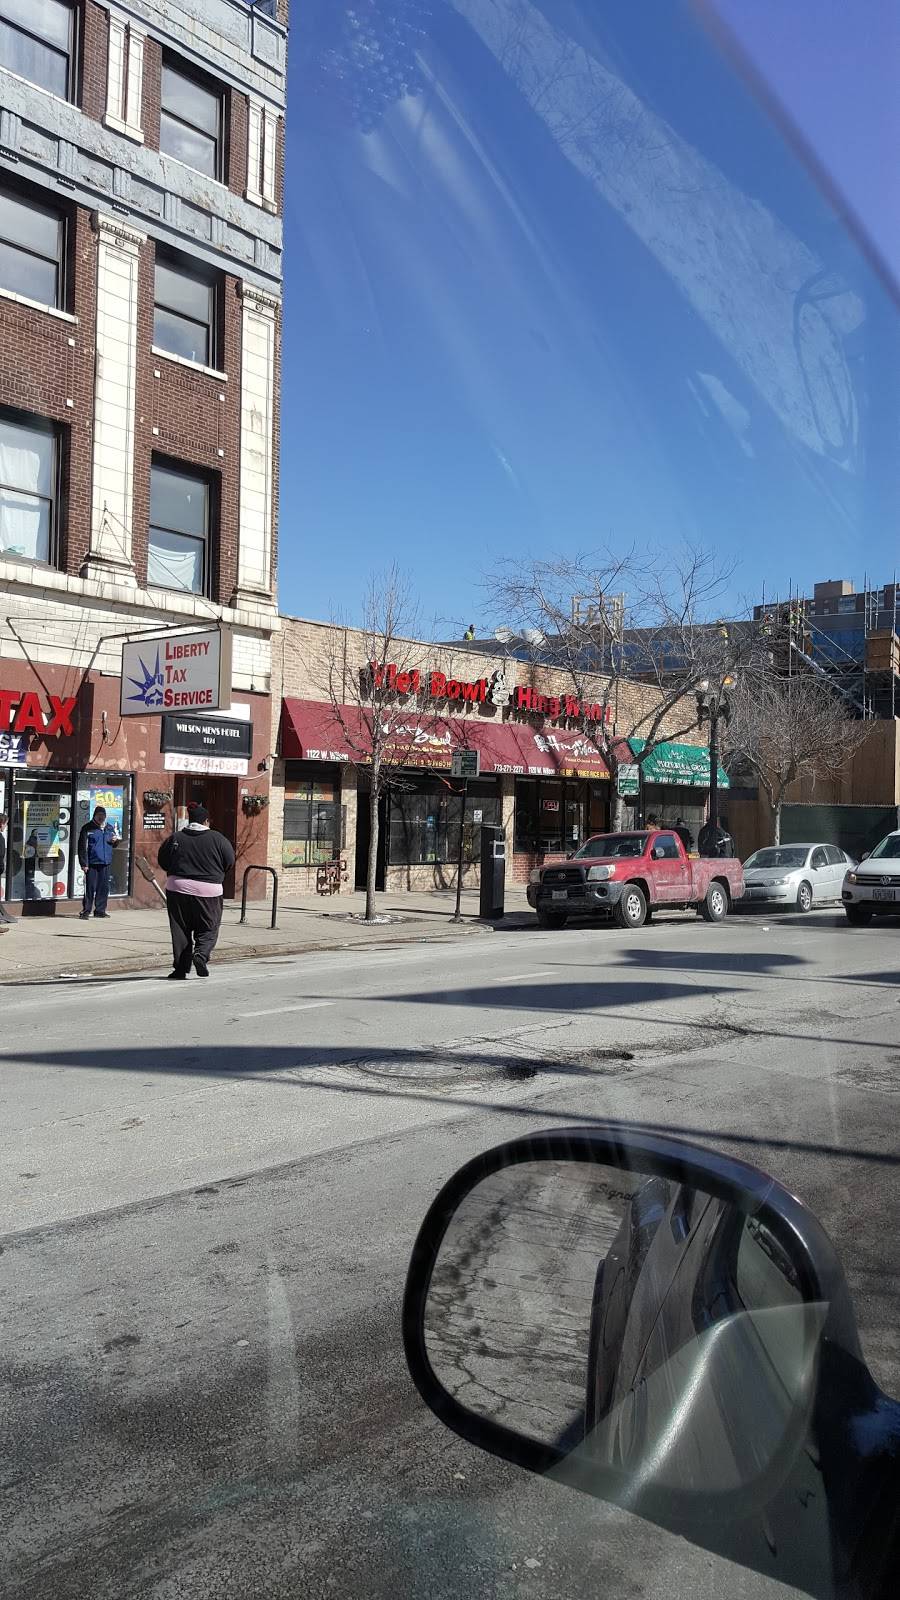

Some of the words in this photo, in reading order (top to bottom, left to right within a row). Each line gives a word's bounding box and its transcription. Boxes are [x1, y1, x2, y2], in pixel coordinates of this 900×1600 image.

[165, 641, 210, 660] LIBERTY
[165, 665, 187, 684] TAX
[431, 671, 487, 703] Bowl
[164, 688, 213, 707] SERVICE
[0, 690, 77, 736] TAX
[176, 723, 201, 734] WILSON
[221, 727, 241, 738] HOTEL
